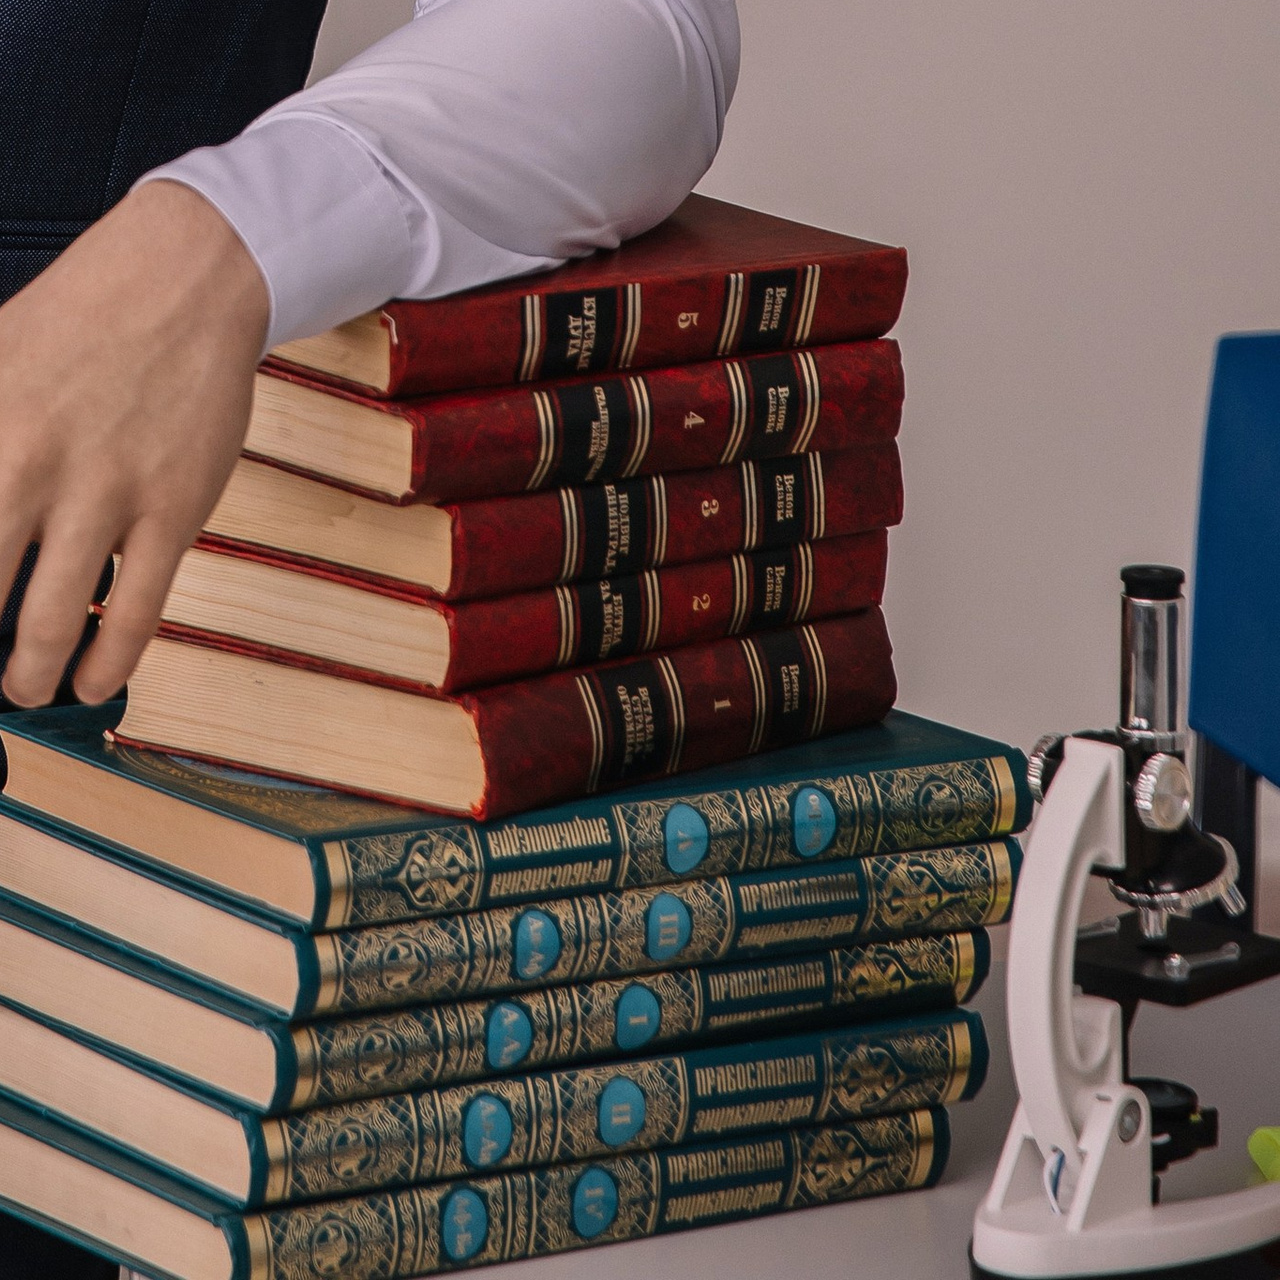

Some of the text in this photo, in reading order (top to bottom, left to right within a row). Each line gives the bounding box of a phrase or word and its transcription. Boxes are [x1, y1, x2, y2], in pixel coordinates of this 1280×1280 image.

[677, 312, 699, 328] 5
[770, 287, 787, 329] Венок
[566, 315, 582, 358] ДУГА
[684, 411, 705, 429] 4
[775, 385, 790, 432] Венок
[701, 499, 720, 517] 3
[783, 473, 795, 519] Венок
[618, 492, 630, 556] ПОДВИГ
[600, 580, 612, 601] ЗА
[692, 593, 711, 611] 2
[773, 565, 786, 610] Венок
[612, 592, 624, 645] БИТВА
[713, 698, 732, 713] 1
[788, 664, 800, 712] Венок
[631, 695, 646, 753] СТРАНА
[658, 913, 678, 947] III
[611, 1104, 632, 1126] II
[585, 1186, 605, 1220] IV
